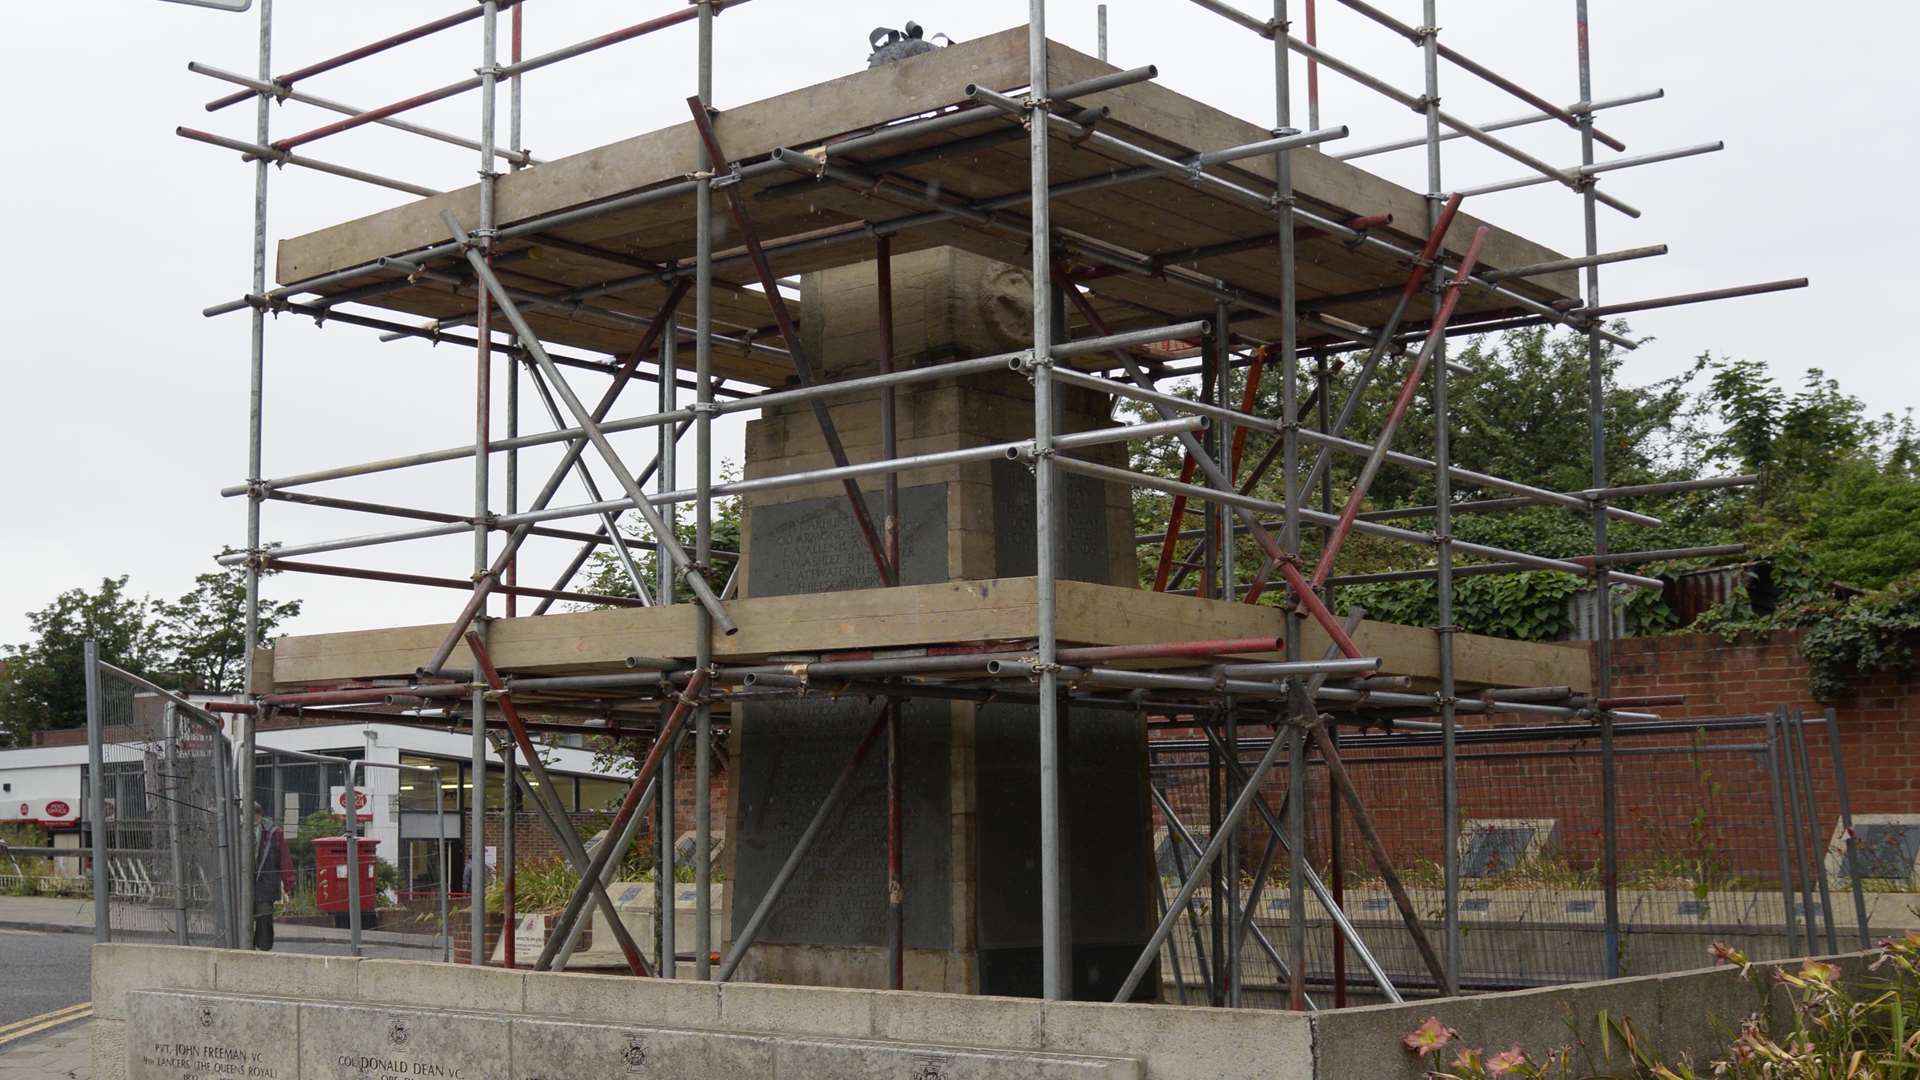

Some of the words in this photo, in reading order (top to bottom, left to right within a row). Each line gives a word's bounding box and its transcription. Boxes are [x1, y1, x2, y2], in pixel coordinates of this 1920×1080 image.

[157, 1057, 191, 1069] LANCERS
[175, 1043, 200, 1057] JOHN
[203, 1046, 247, 1062] FREEMAN
[251, 1052, 263, 1063] VC
[361, 1056, 408, 1074] DONALD
[413, 1062, 444, 1078] DEAN
